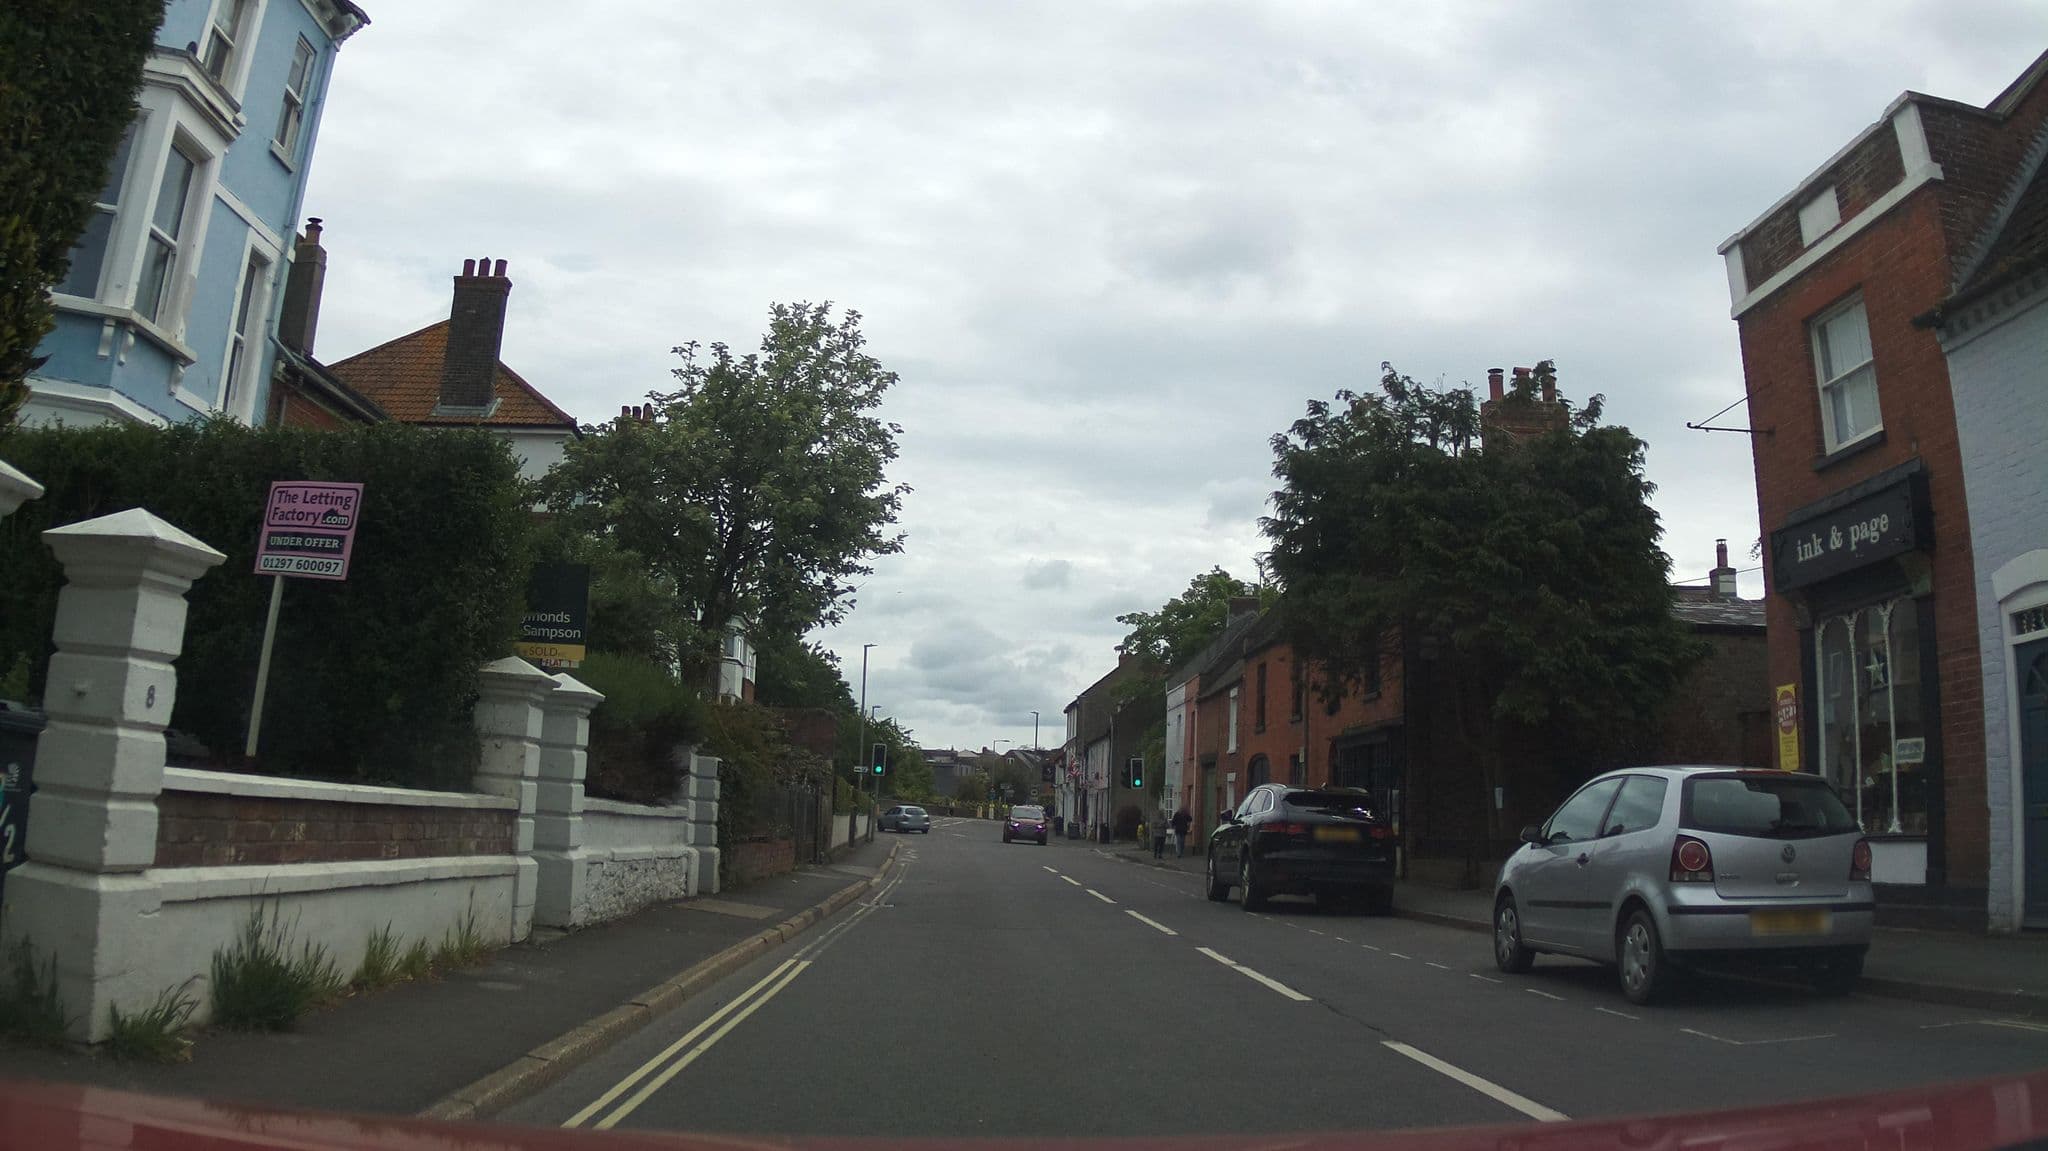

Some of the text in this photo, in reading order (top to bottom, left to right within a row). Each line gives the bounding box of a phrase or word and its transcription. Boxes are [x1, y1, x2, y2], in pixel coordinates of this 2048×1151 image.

[277, 490, 353, 511] The Letting
[271, 507, 321, 526] Factory
[270, 536, 340, 549] UNDER OFFER
[1797, 513, 1889, 563] ink & page
[263, 557, 340, 573] 01297 600097
[521, 611, 571, 624] ymonds
[523, 624, 581, 640] Sampson
[529, 646, 558, 657] SOLD
[146, 684, 156, 709] 8
